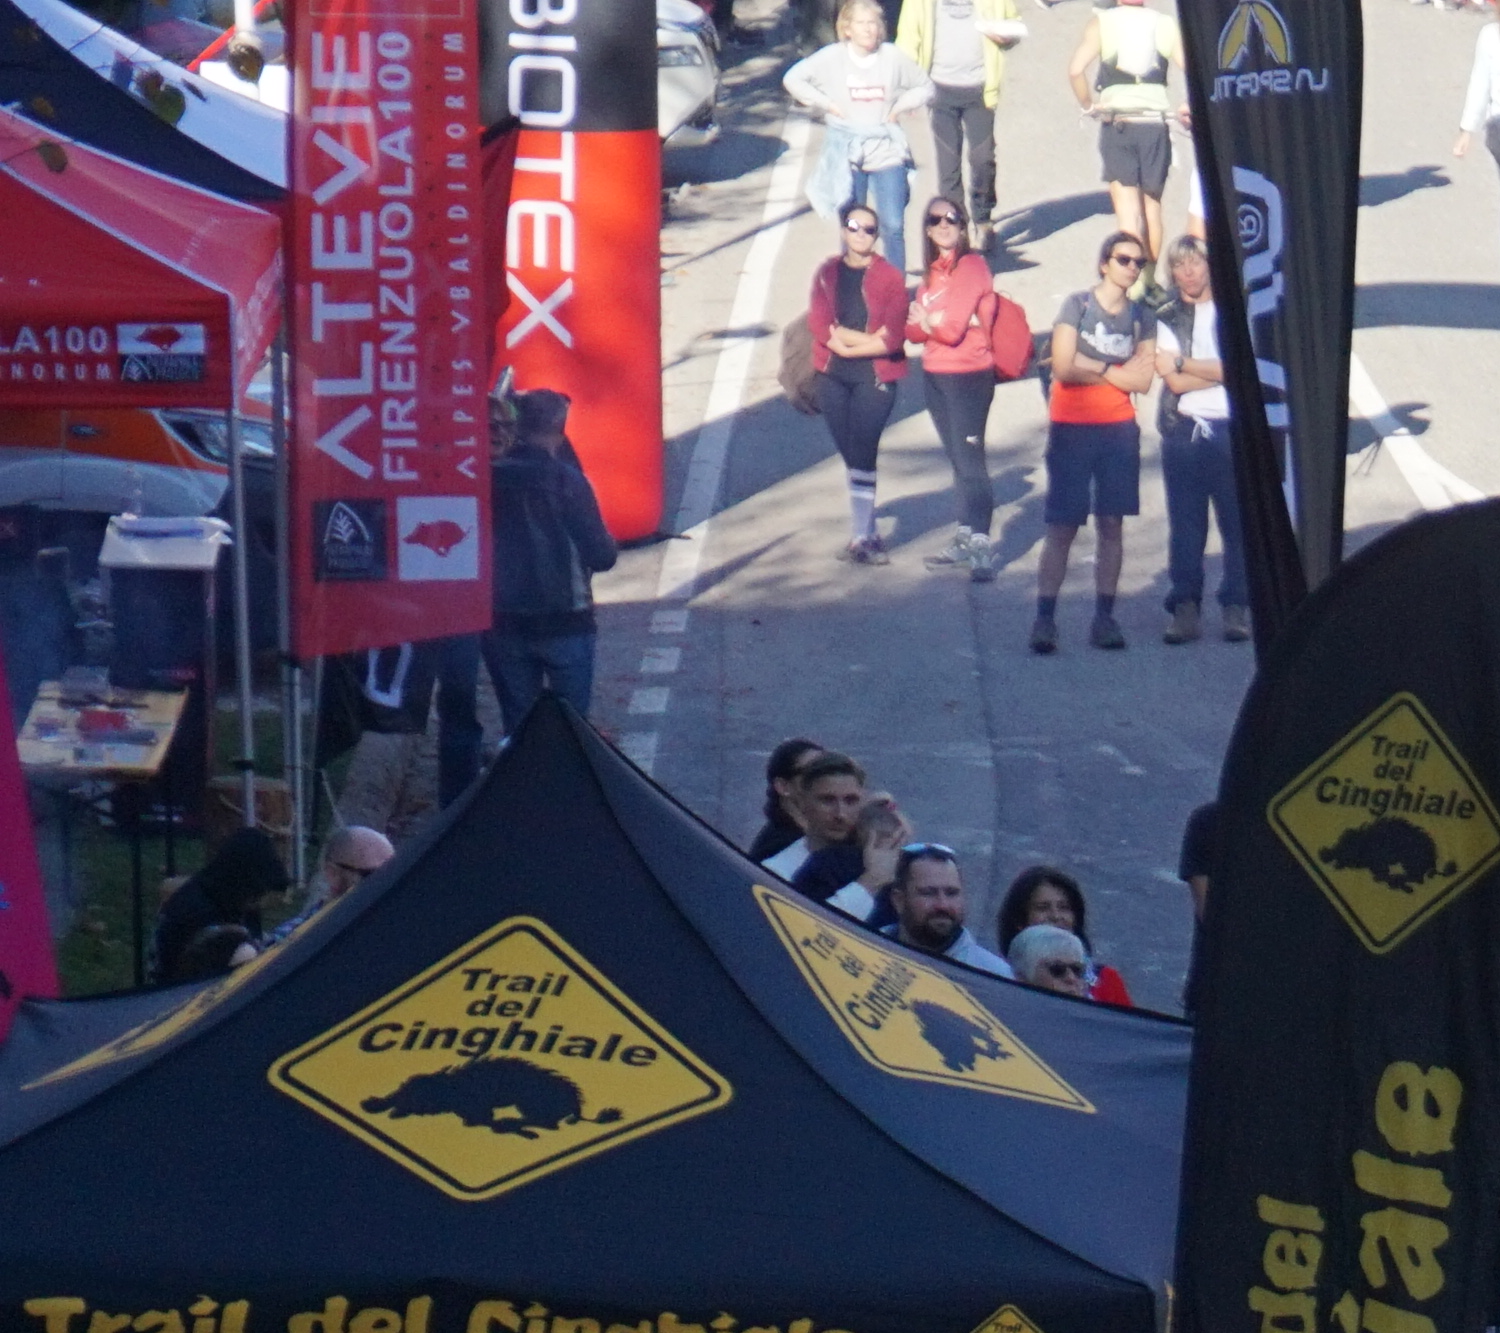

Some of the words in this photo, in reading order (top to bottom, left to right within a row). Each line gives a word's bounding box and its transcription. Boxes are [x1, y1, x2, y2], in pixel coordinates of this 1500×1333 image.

[377, 31, 418, 482] FIRENZUOLA100
[0, 326, 109, 354] A100
[451, 357, 477, 479] ALPES
[1368, 734, 1430, 761] Trail
[1374, 759, 1414, 783] del
[1315, 776, 1477, 822] Cinghiale
[460, 967, 568, 997] Trail
[467, 994, 542, 1021] del
[358, 1022, 661, 1069] Cinghiale
